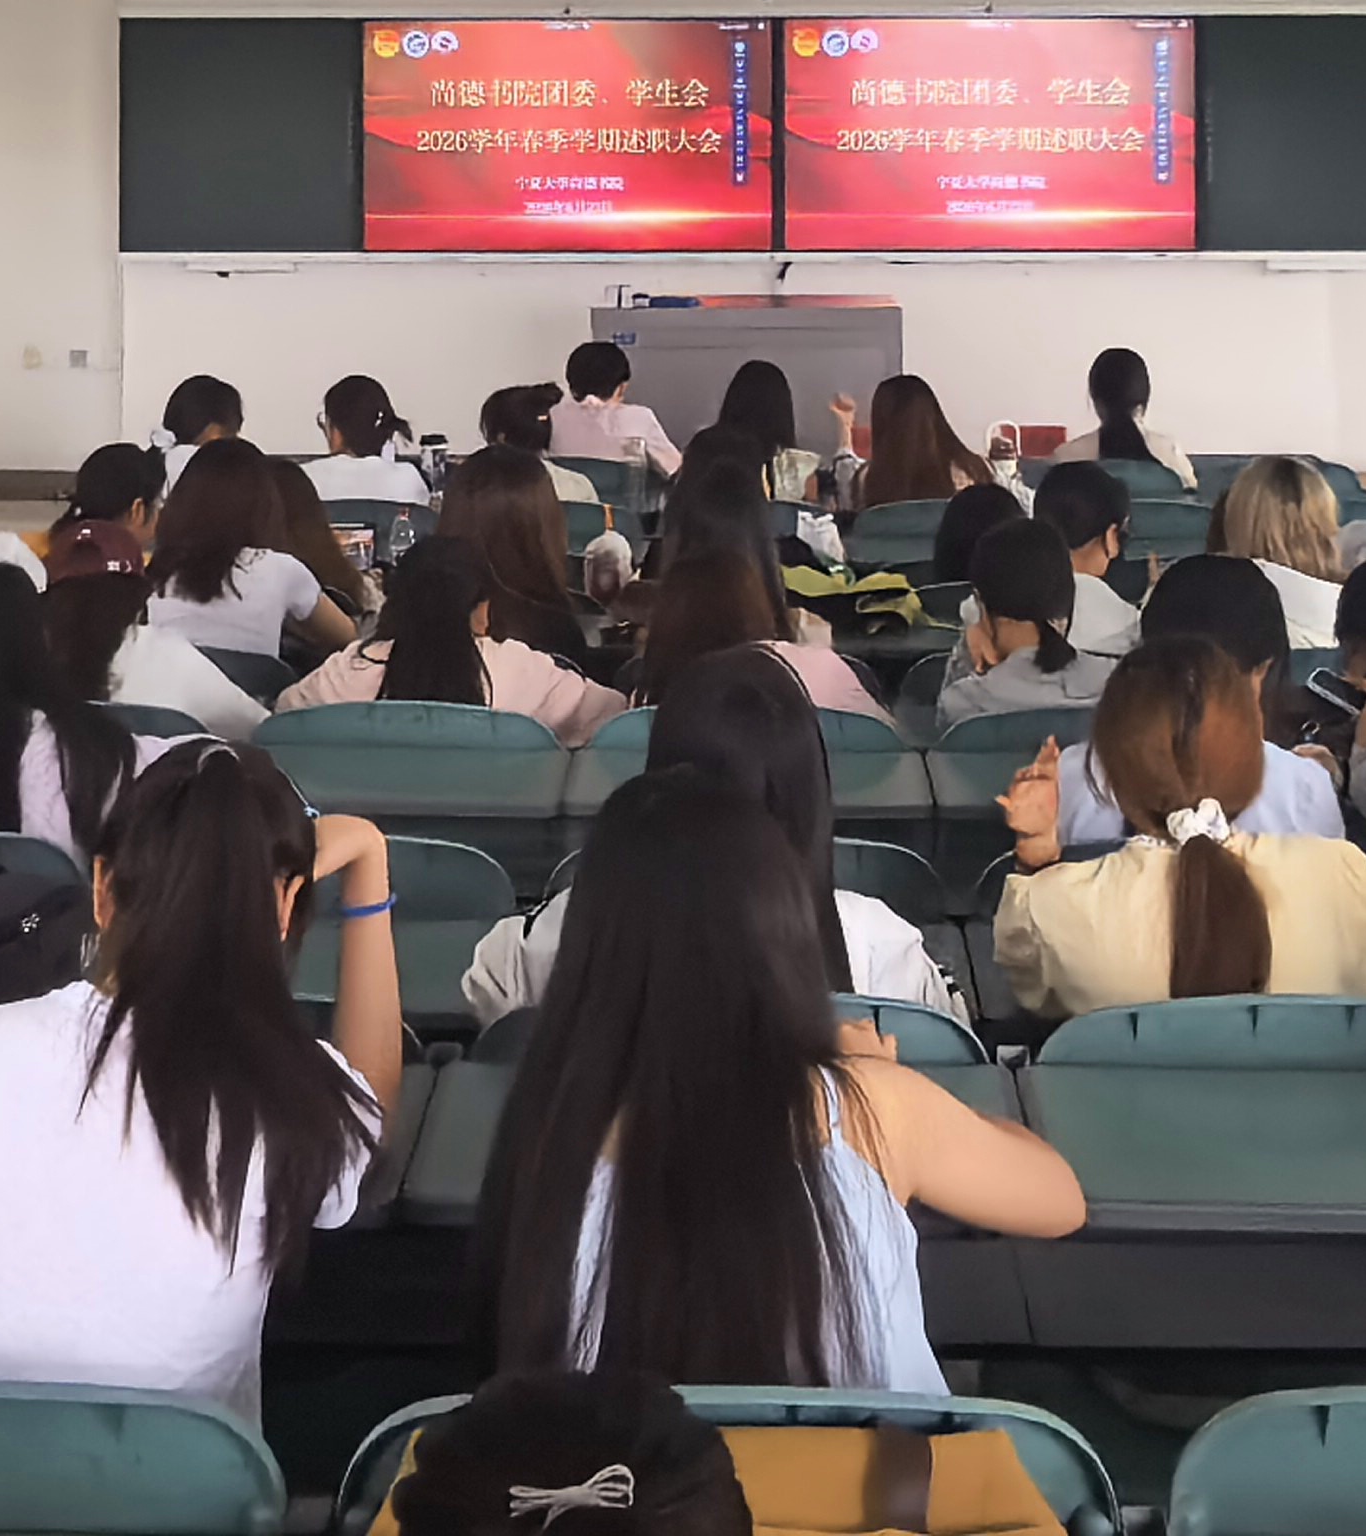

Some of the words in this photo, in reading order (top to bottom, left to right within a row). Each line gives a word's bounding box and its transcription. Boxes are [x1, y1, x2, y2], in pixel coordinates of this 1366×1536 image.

[430, 78, 710, 108] 尚德书院团委、学生会
[851, 76, 1132, 107] 尚德书院团委、学生会
[416, 129, 723, 154] 2026学年春季学期述职大会
[836, 127, 1146, 153] 2026学年春季学期述职大会
